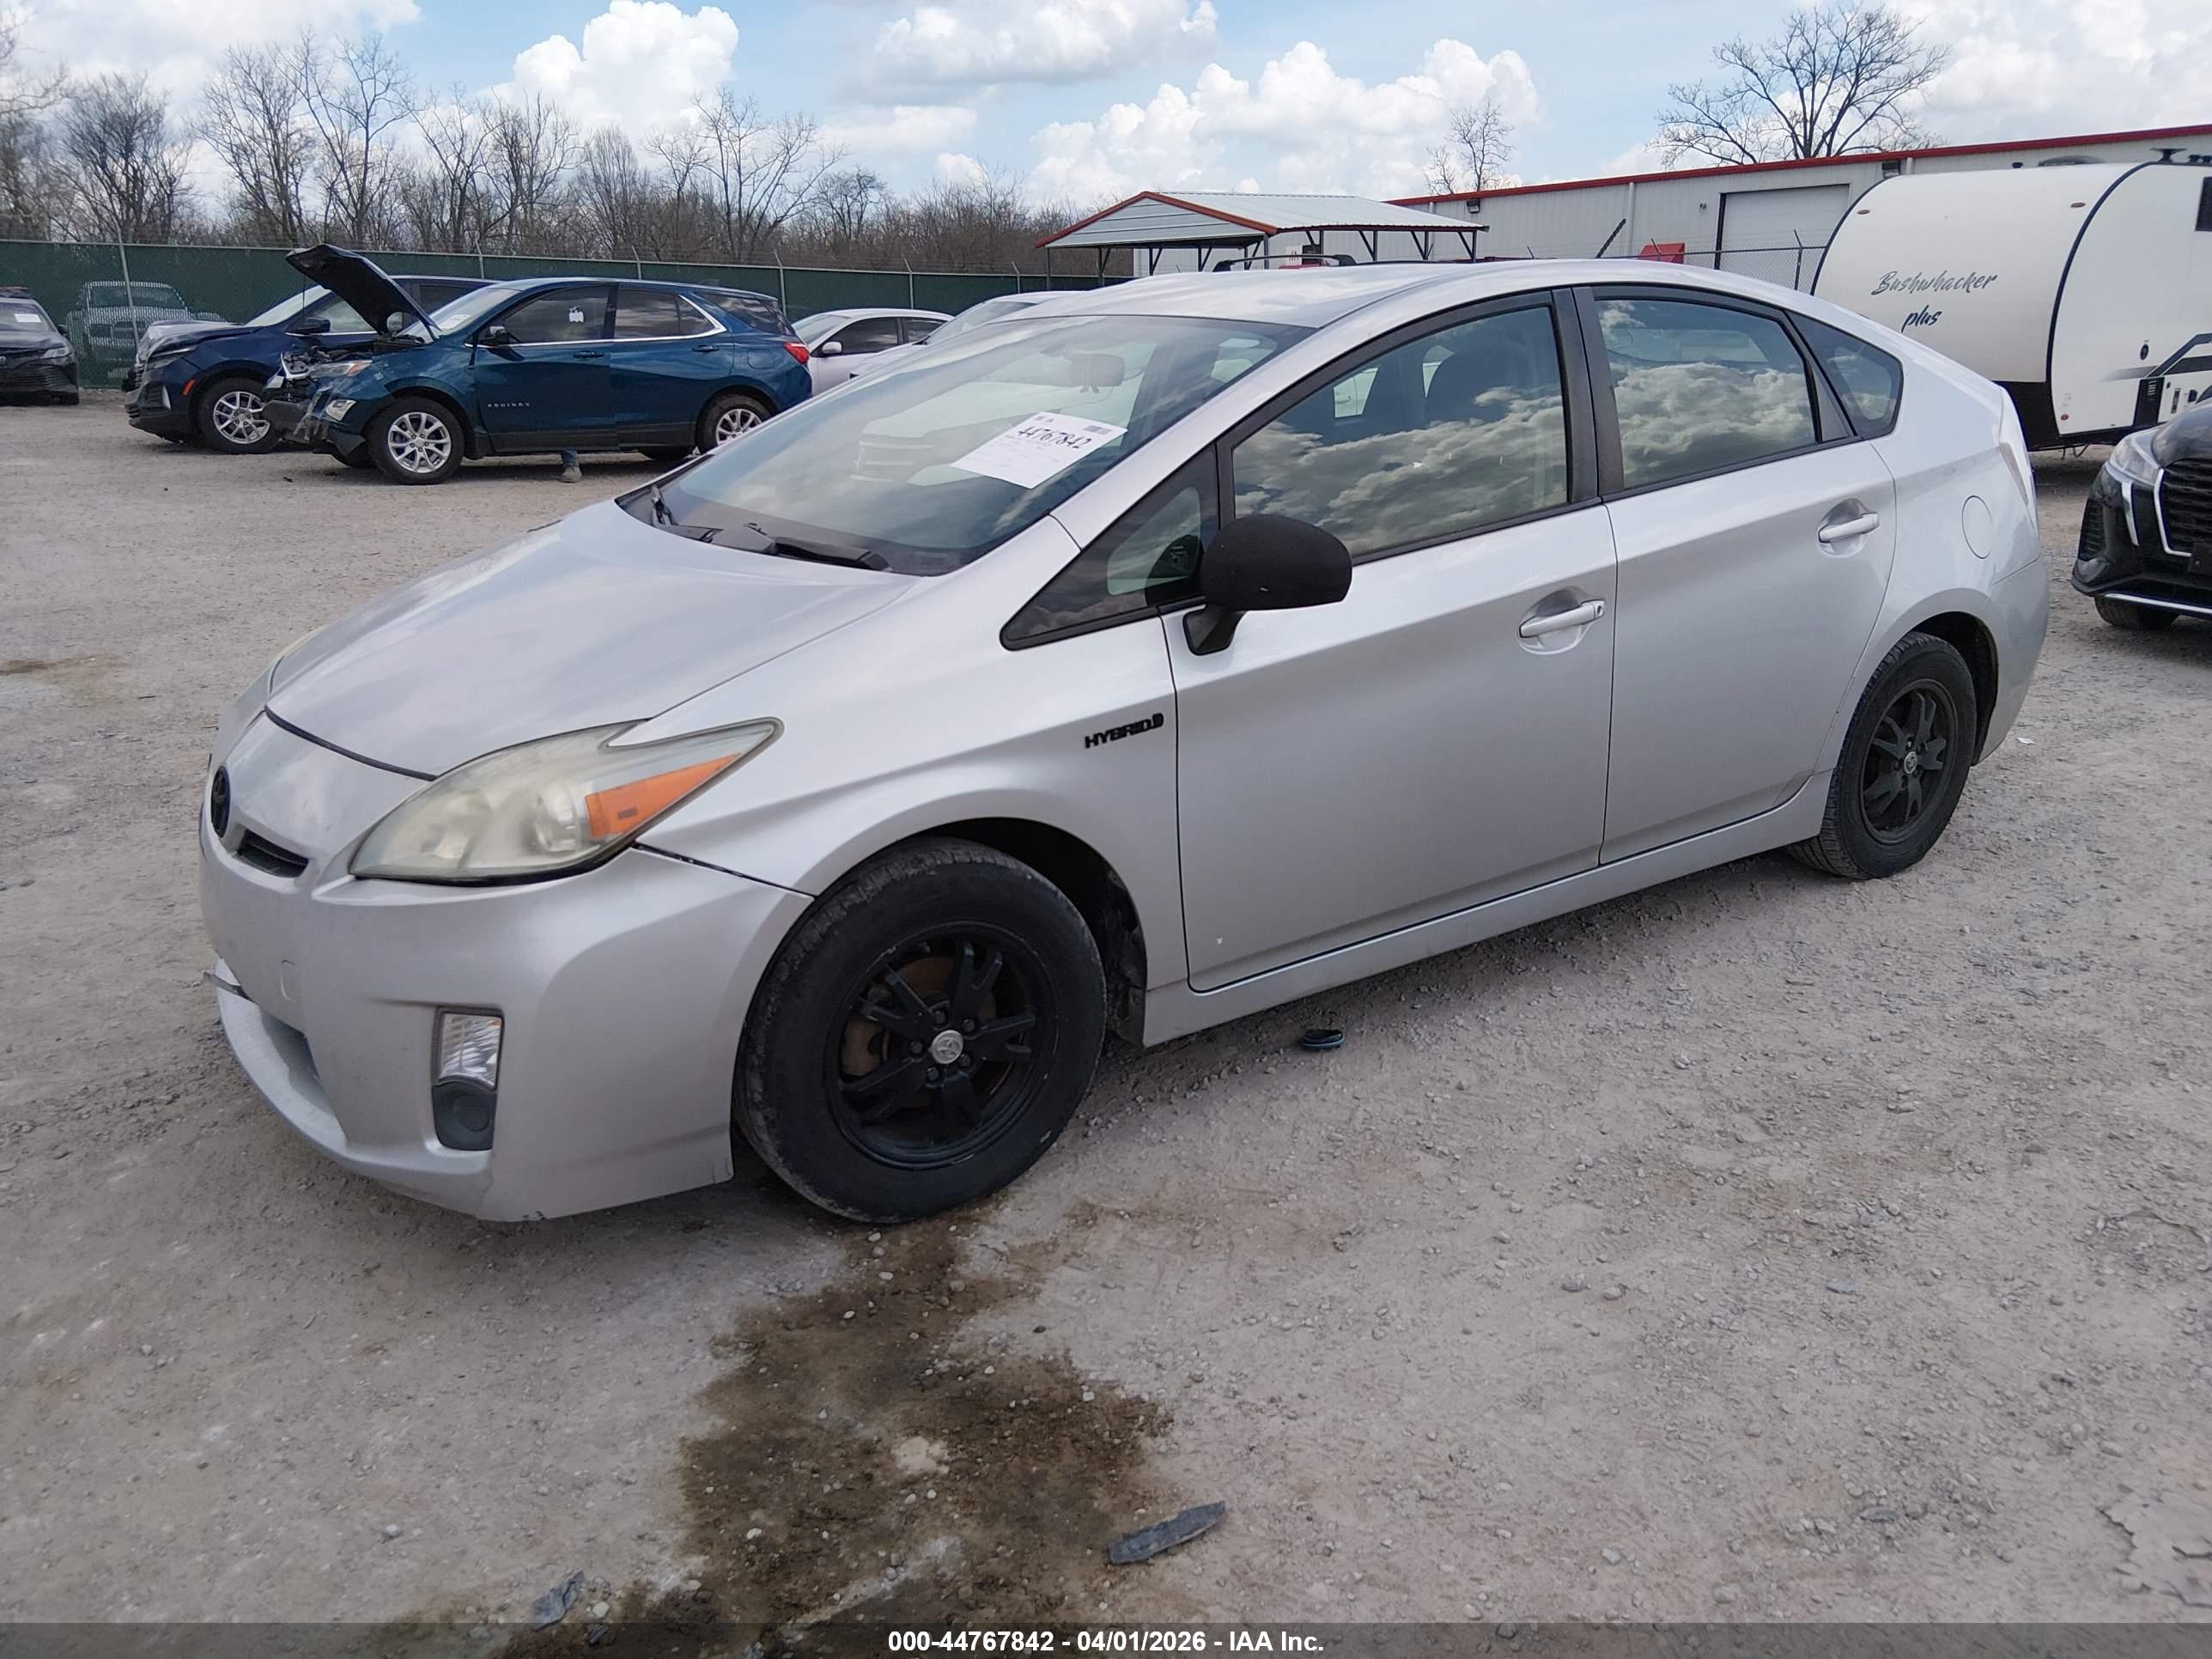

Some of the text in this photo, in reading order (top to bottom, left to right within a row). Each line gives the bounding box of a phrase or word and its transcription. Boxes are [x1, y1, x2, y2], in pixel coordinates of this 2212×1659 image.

[1870, 270, 1998, 295] Bushwhacker
[1900, 304, 1943, 333] plus
[1018, 426, 1092, 448] 44767842
[1085, 719, 1152, 749] HYBRID
